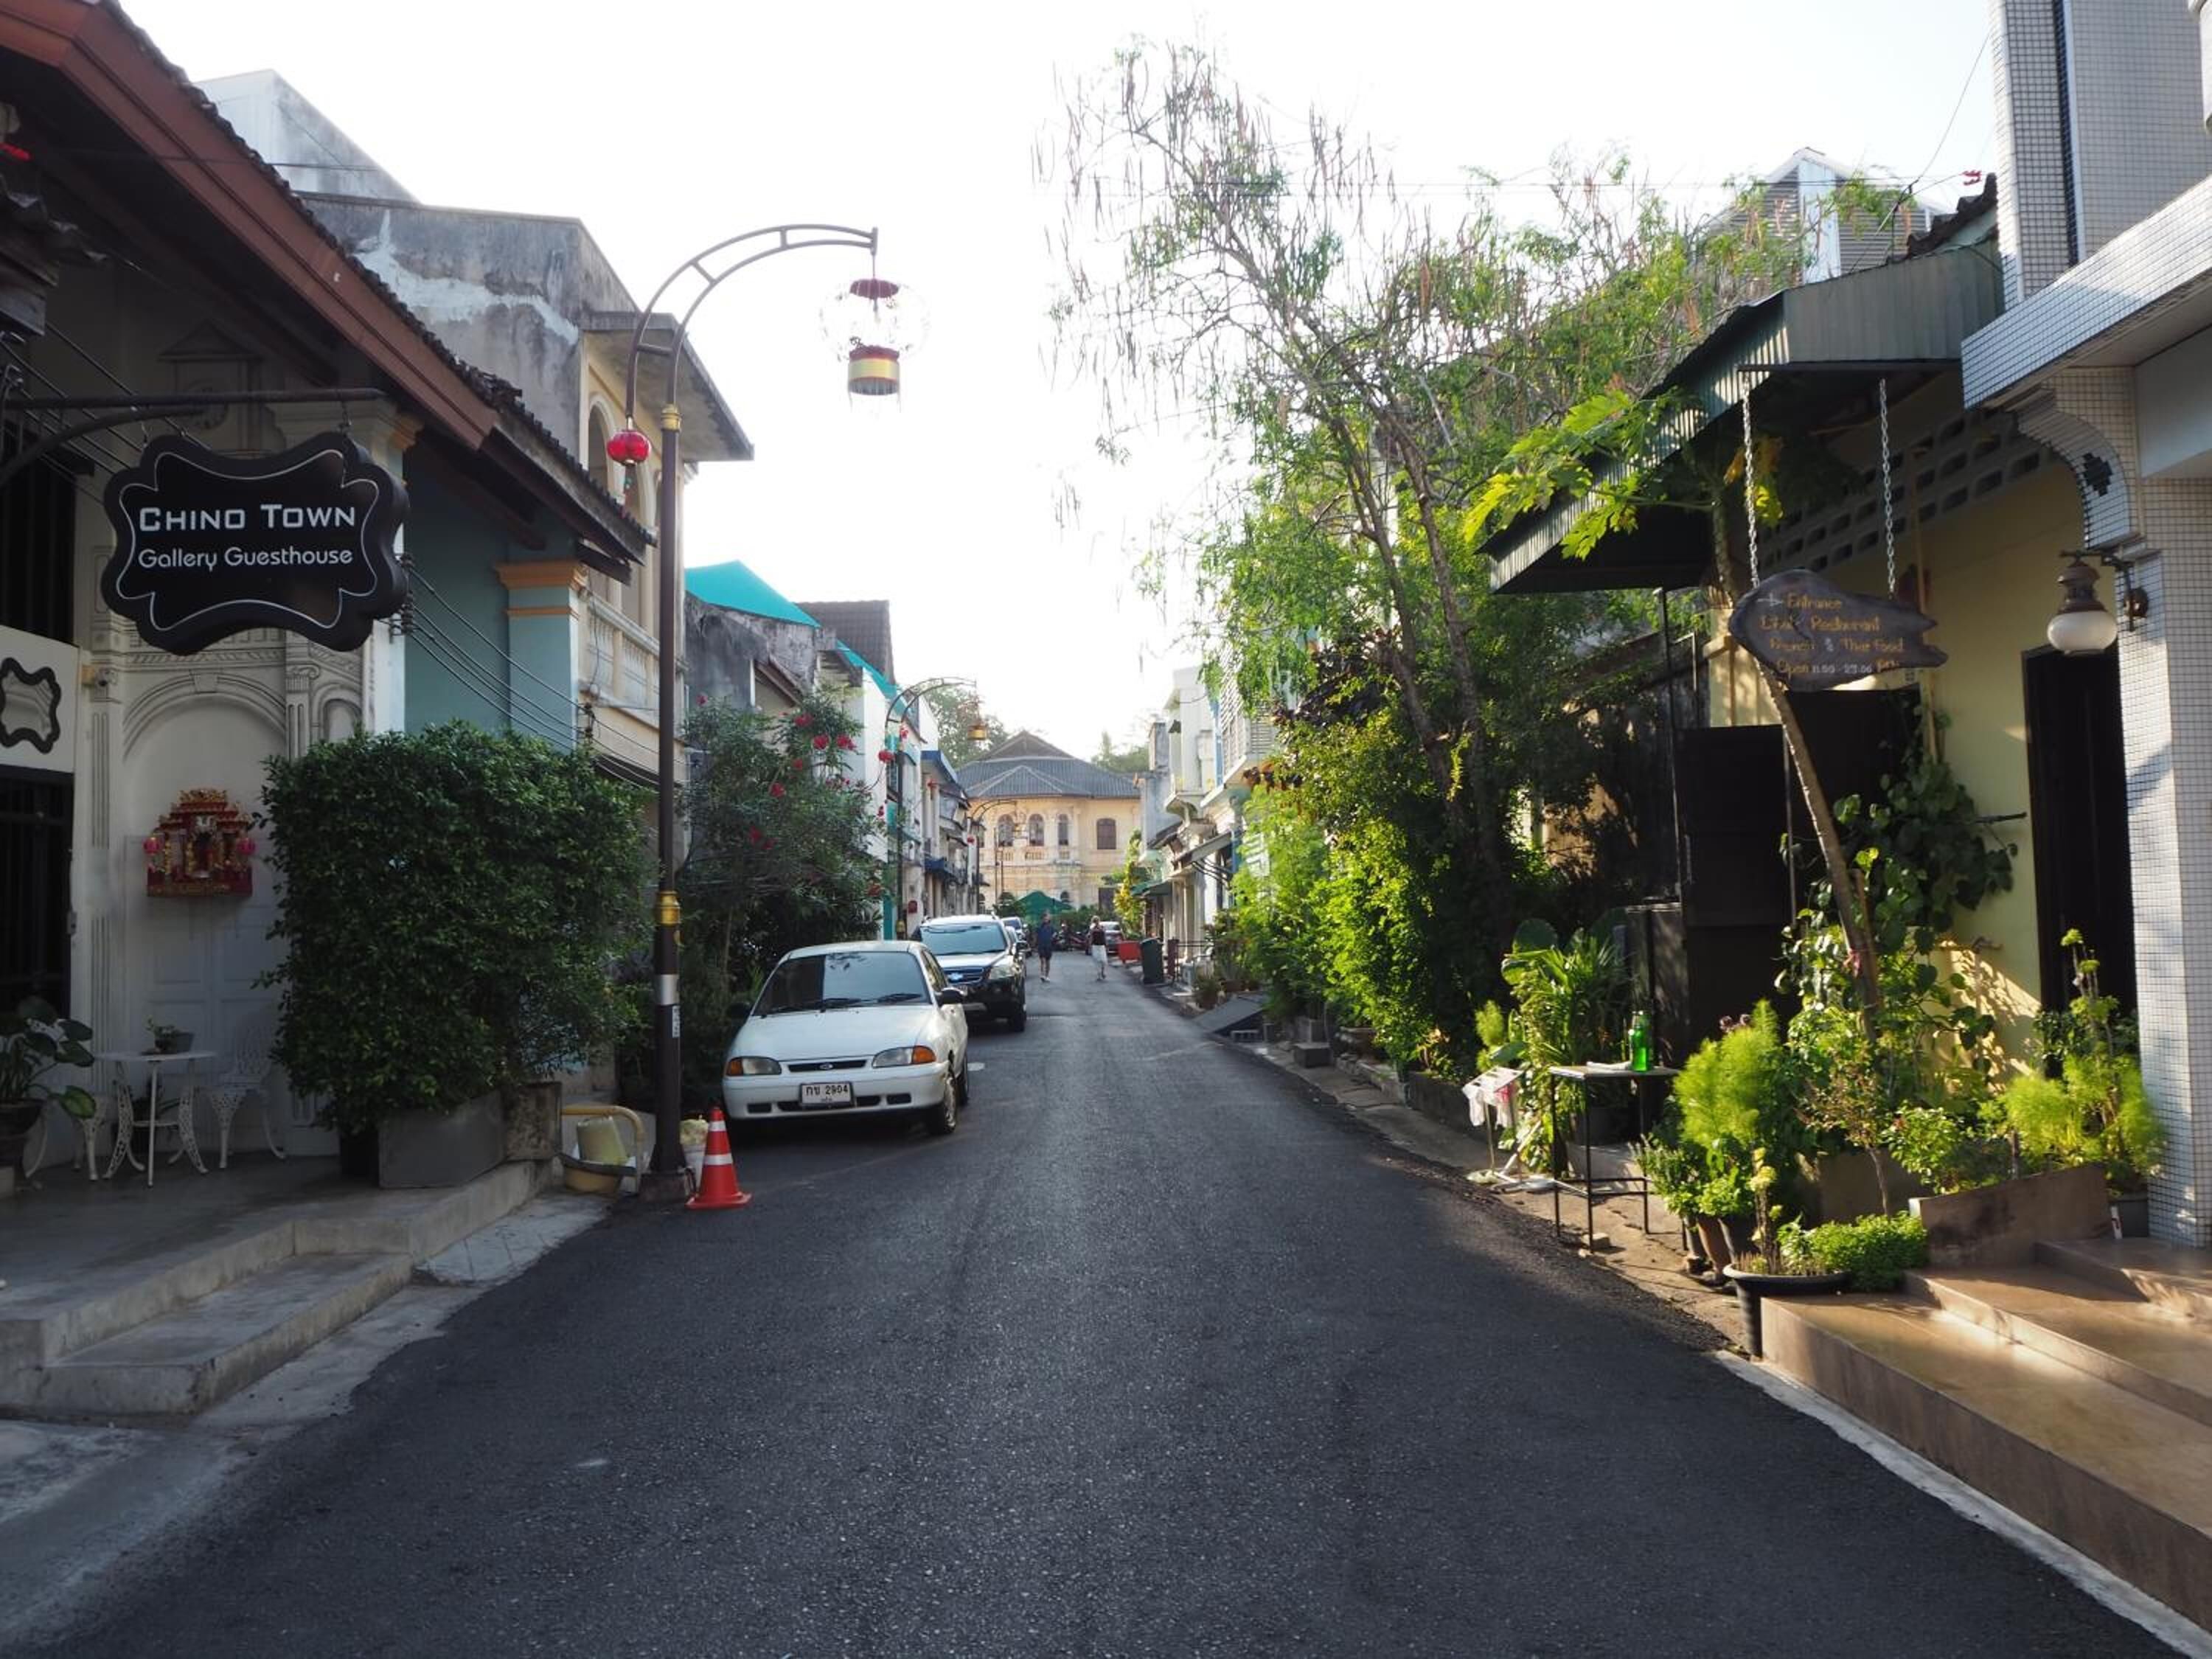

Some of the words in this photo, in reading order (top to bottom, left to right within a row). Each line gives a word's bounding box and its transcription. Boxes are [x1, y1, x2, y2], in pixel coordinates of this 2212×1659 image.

[138, 548, 218, 572] Gallery
[224, 546, 353, 566] Guesthouse
[1787, 593, 1842, 610] Entrance
